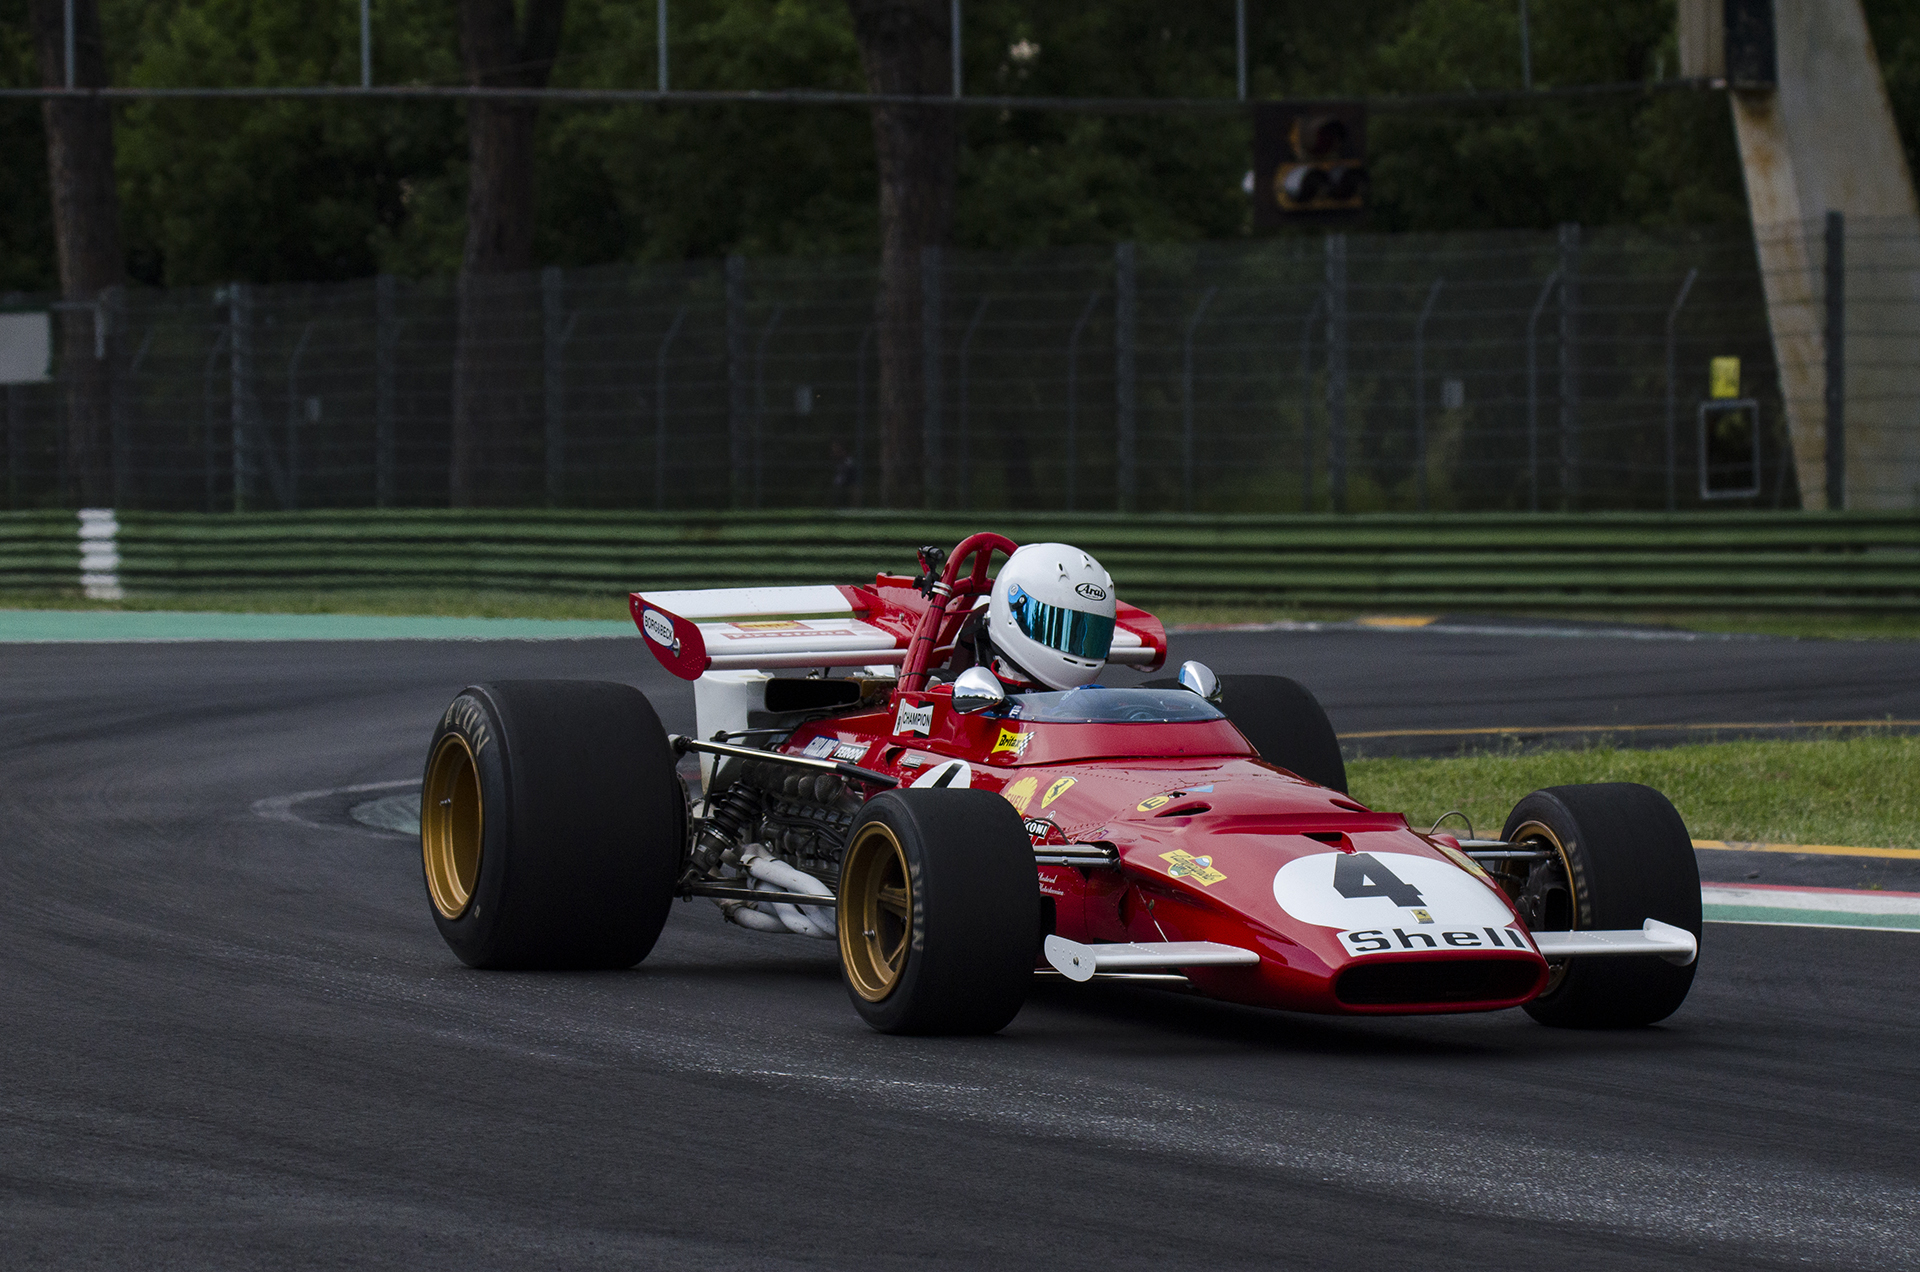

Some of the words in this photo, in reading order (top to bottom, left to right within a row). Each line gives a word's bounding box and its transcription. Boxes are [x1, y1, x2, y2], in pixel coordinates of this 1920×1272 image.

[1078, 585, 1103, 597] Arai
[903, 712, 930, 727] CHAMPION
[444, 701, 491, 757] AVON
[999, 734, 1020, 748] Britax
[833, 746, 864, 761] FERODO
[1333, 852, 1427, 908] 4
[1348, 927, 1527, 952] Shell
